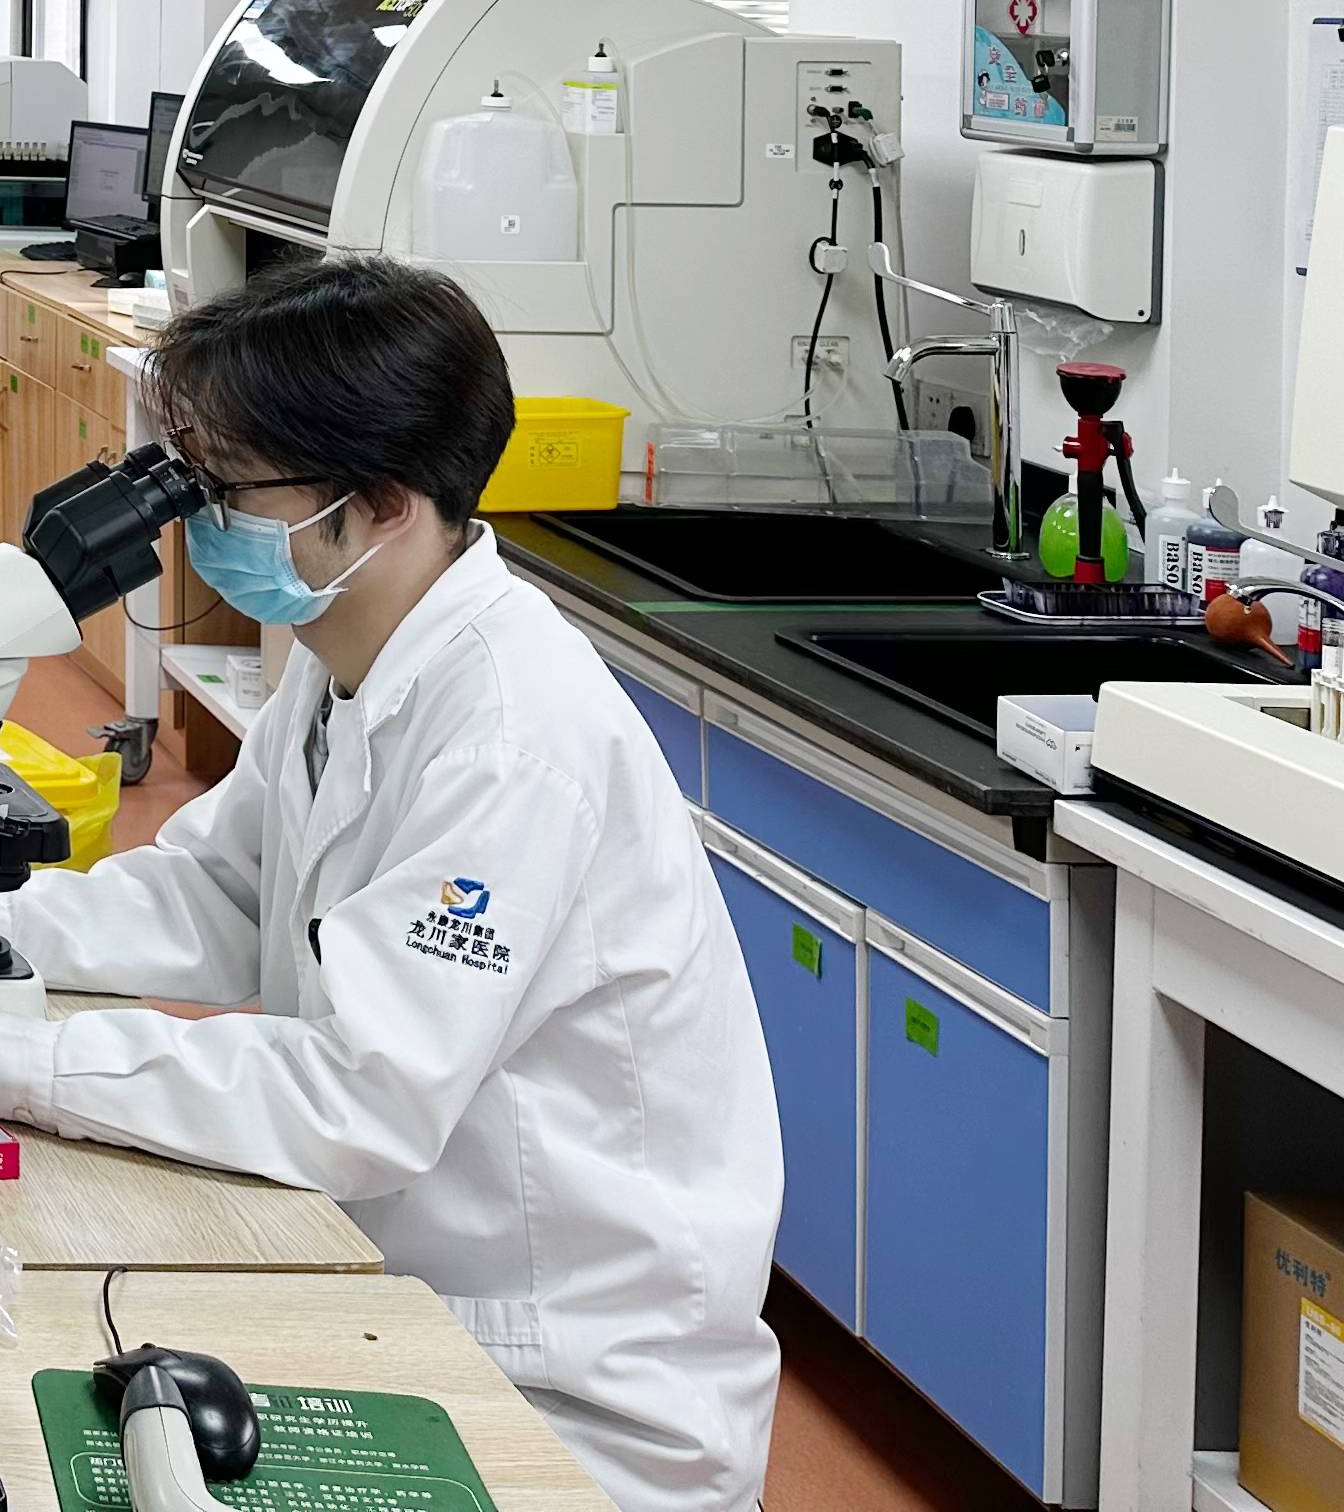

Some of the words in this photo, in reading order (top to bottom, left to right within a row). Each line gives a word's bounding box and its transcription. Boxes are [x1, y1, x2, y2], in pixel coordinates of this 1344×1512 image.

[1166, 542, 1180, 584] Baso
[1192, 552, 1203, 594] Baso
[406, 920, 510, 963] 龙川家医院
[406, 936, 457, 962] Longchuan
[462, 955, 508, 974] Hospital
[1276, 1247, 1327, 1297] 优利特
[297, 1395, 353, 1414] 培训
